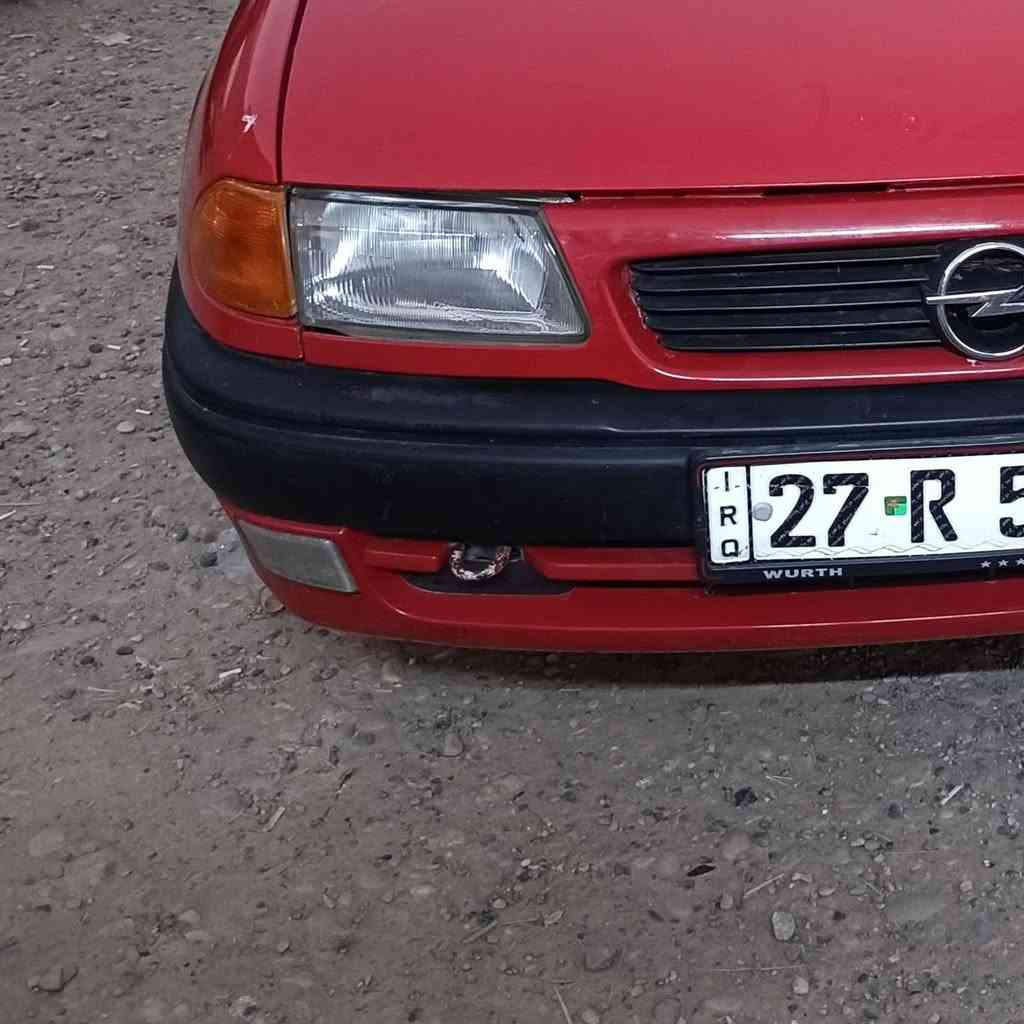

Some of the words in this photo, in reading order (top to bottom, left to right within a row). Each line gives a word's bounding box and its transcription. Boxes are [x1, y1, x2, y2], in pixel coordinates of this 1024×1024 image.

[768, 472, 869, 548] 27
[910, 468, 959, 544] R
[762, 567, 843, 580] WURTH
